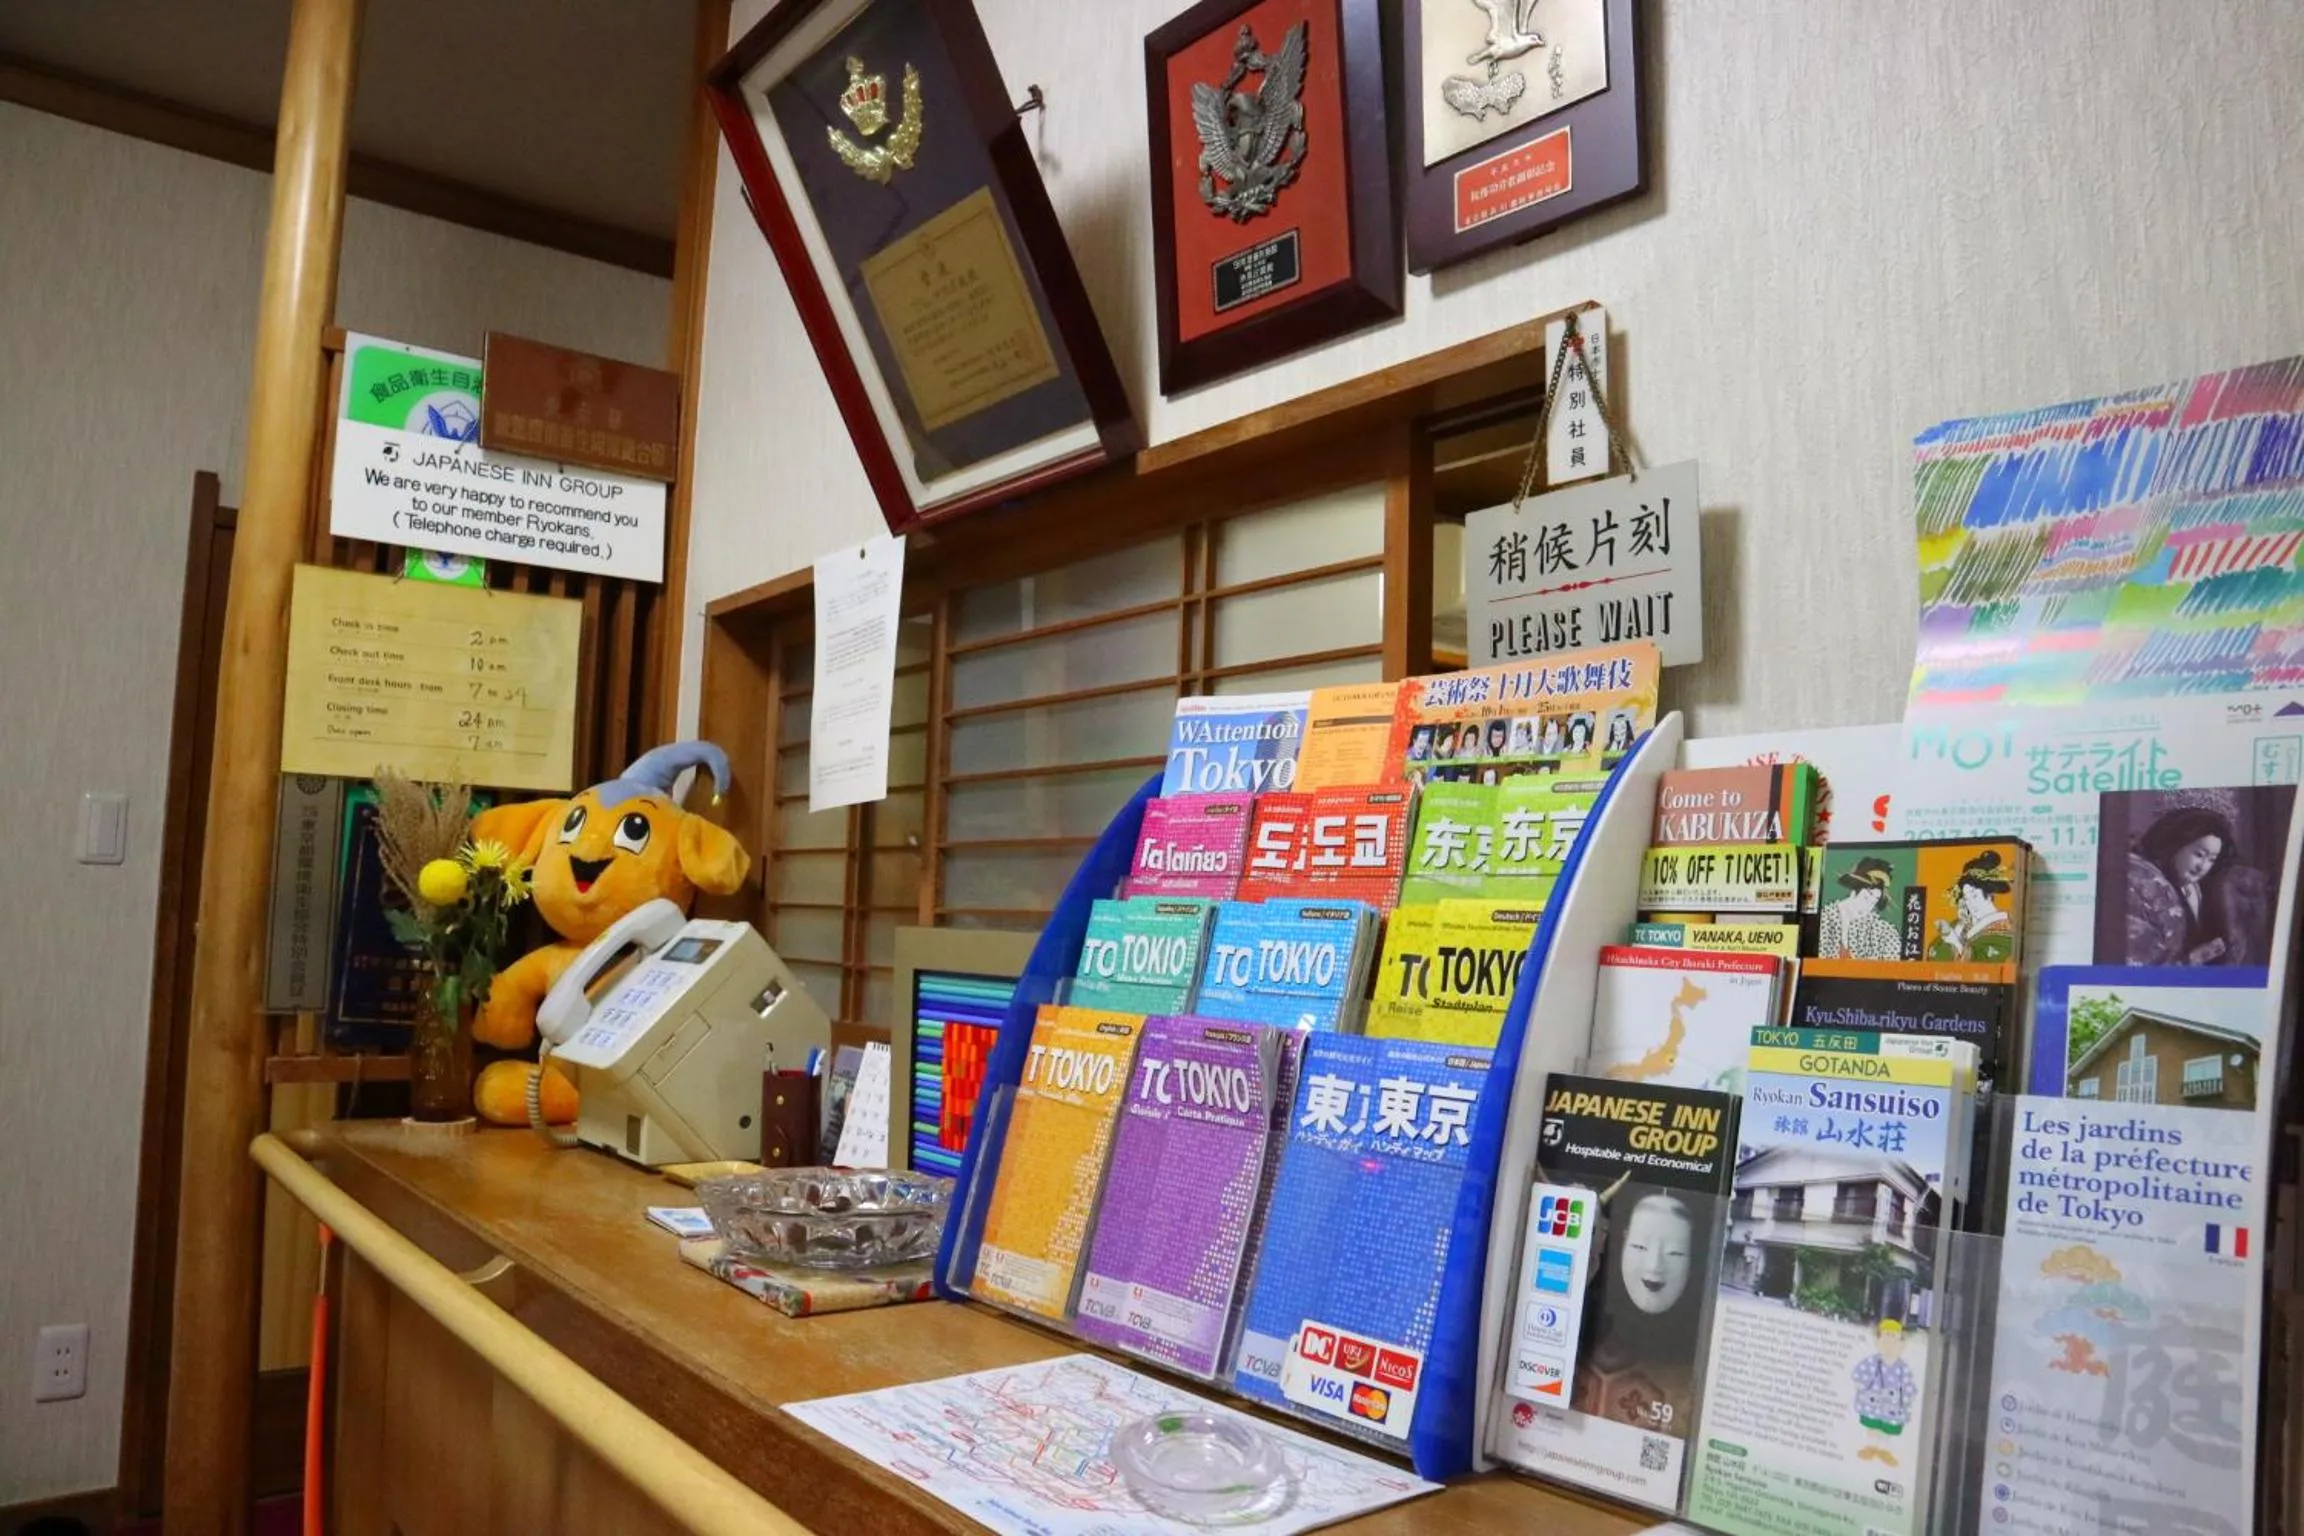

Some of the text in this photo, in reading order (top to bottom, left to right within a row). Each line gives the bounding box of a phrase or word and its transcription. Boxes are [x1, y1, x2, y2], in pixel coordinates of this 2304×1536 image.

[1568, 363, 1587, 468] 特別社員
[413, 452, 623, 499] JAPANESE INN GROUP
[365, 467, 639, 528] We are very happy to recommend you
[412, 497, 428, 512] to
[431, 502, 458, 516] our
[461, 507, 522, 527] member
[404, 511, 481, 539] Telephone
[485, 526, 536, 549] charge
[1488, 498, 1671, 585] 稍候片刻
[1489, 591, 1674, 658] PLEASE WAIT
[470, 657, 484, 673] 10
[1424, 658, 1634, 707] 芸術祭 十月大歌舞伎
[1177, 719, 1300, 744] WAttention
[1910, 719, 2022, 770] MOT
[1171, 746, 1299, 795] Tokyo
[2024, 735, 2168, 774] サテライト
[2026, 761, 2183, 795] Satellite
[1661, 787, 1741, 810] Come to
[1311, 815, 1389, 868] 도쿄
[1658, 810, 1784, 842] KABUKIZA
[1653, 855, 1678, 886] 10%
[1687, 854, 1716, 885] OFF
[1725, 851, 1790, 885] TICKET!
[1647, 928, 1784, 945] TOKYO YANAKA, UENO
[1905, 894, 1922, 960] 花のお江
[1122, 934, 1187, 976] TOKIO
[1258, 939, 1337, 988] TOKYO
[1660, 957, 1681, 968] City
[1682, 957, 1716, 970] Ibaraki
[1923, 982, 1932, 993] of
[1756, 1029, 1858, 1051] TOKYO 五反田
[1921, 1012, 1987, 1034] Gardens
[1047, 1047, 1115, 1096] TOKYO
[1799, 1055, 1891, 1078] GOTANDA
[1173, 1058, 1250, 1114] TOKYO
[1753, 1081, 1940, 1120] Ryokan Sansuiso
[1373, 1075, 1479, 1148] 東京
[1545, 1090, 1721, 1132] JAPANESE INN
[2024, 1111, 2183, 1146] Les jardins
[1629, 1125, 1718, 1158] GROUP
[1815, 1116, 1908, 1153] 山水荘
[1565, 1142, 1714, 1174] Hospitable and Economical
[2021, 1138, 2253, 1183] de la préfecture
[2019, 1167, 2244, 1210] métropolitaine
[1539, 1209, 1582, 1226] JCB
[2017, 1192, 2144, 1230] de Tokyo
[1302, 1331, 1335, 1361] DC
[1244, 1353, 1281, 1378] TCVB
[1519, 1359, 1561, 1379] DISCOVER
[1309, 1373, 1345, 1402] VISA
[1651, 1400, 1674, 1423] 59
